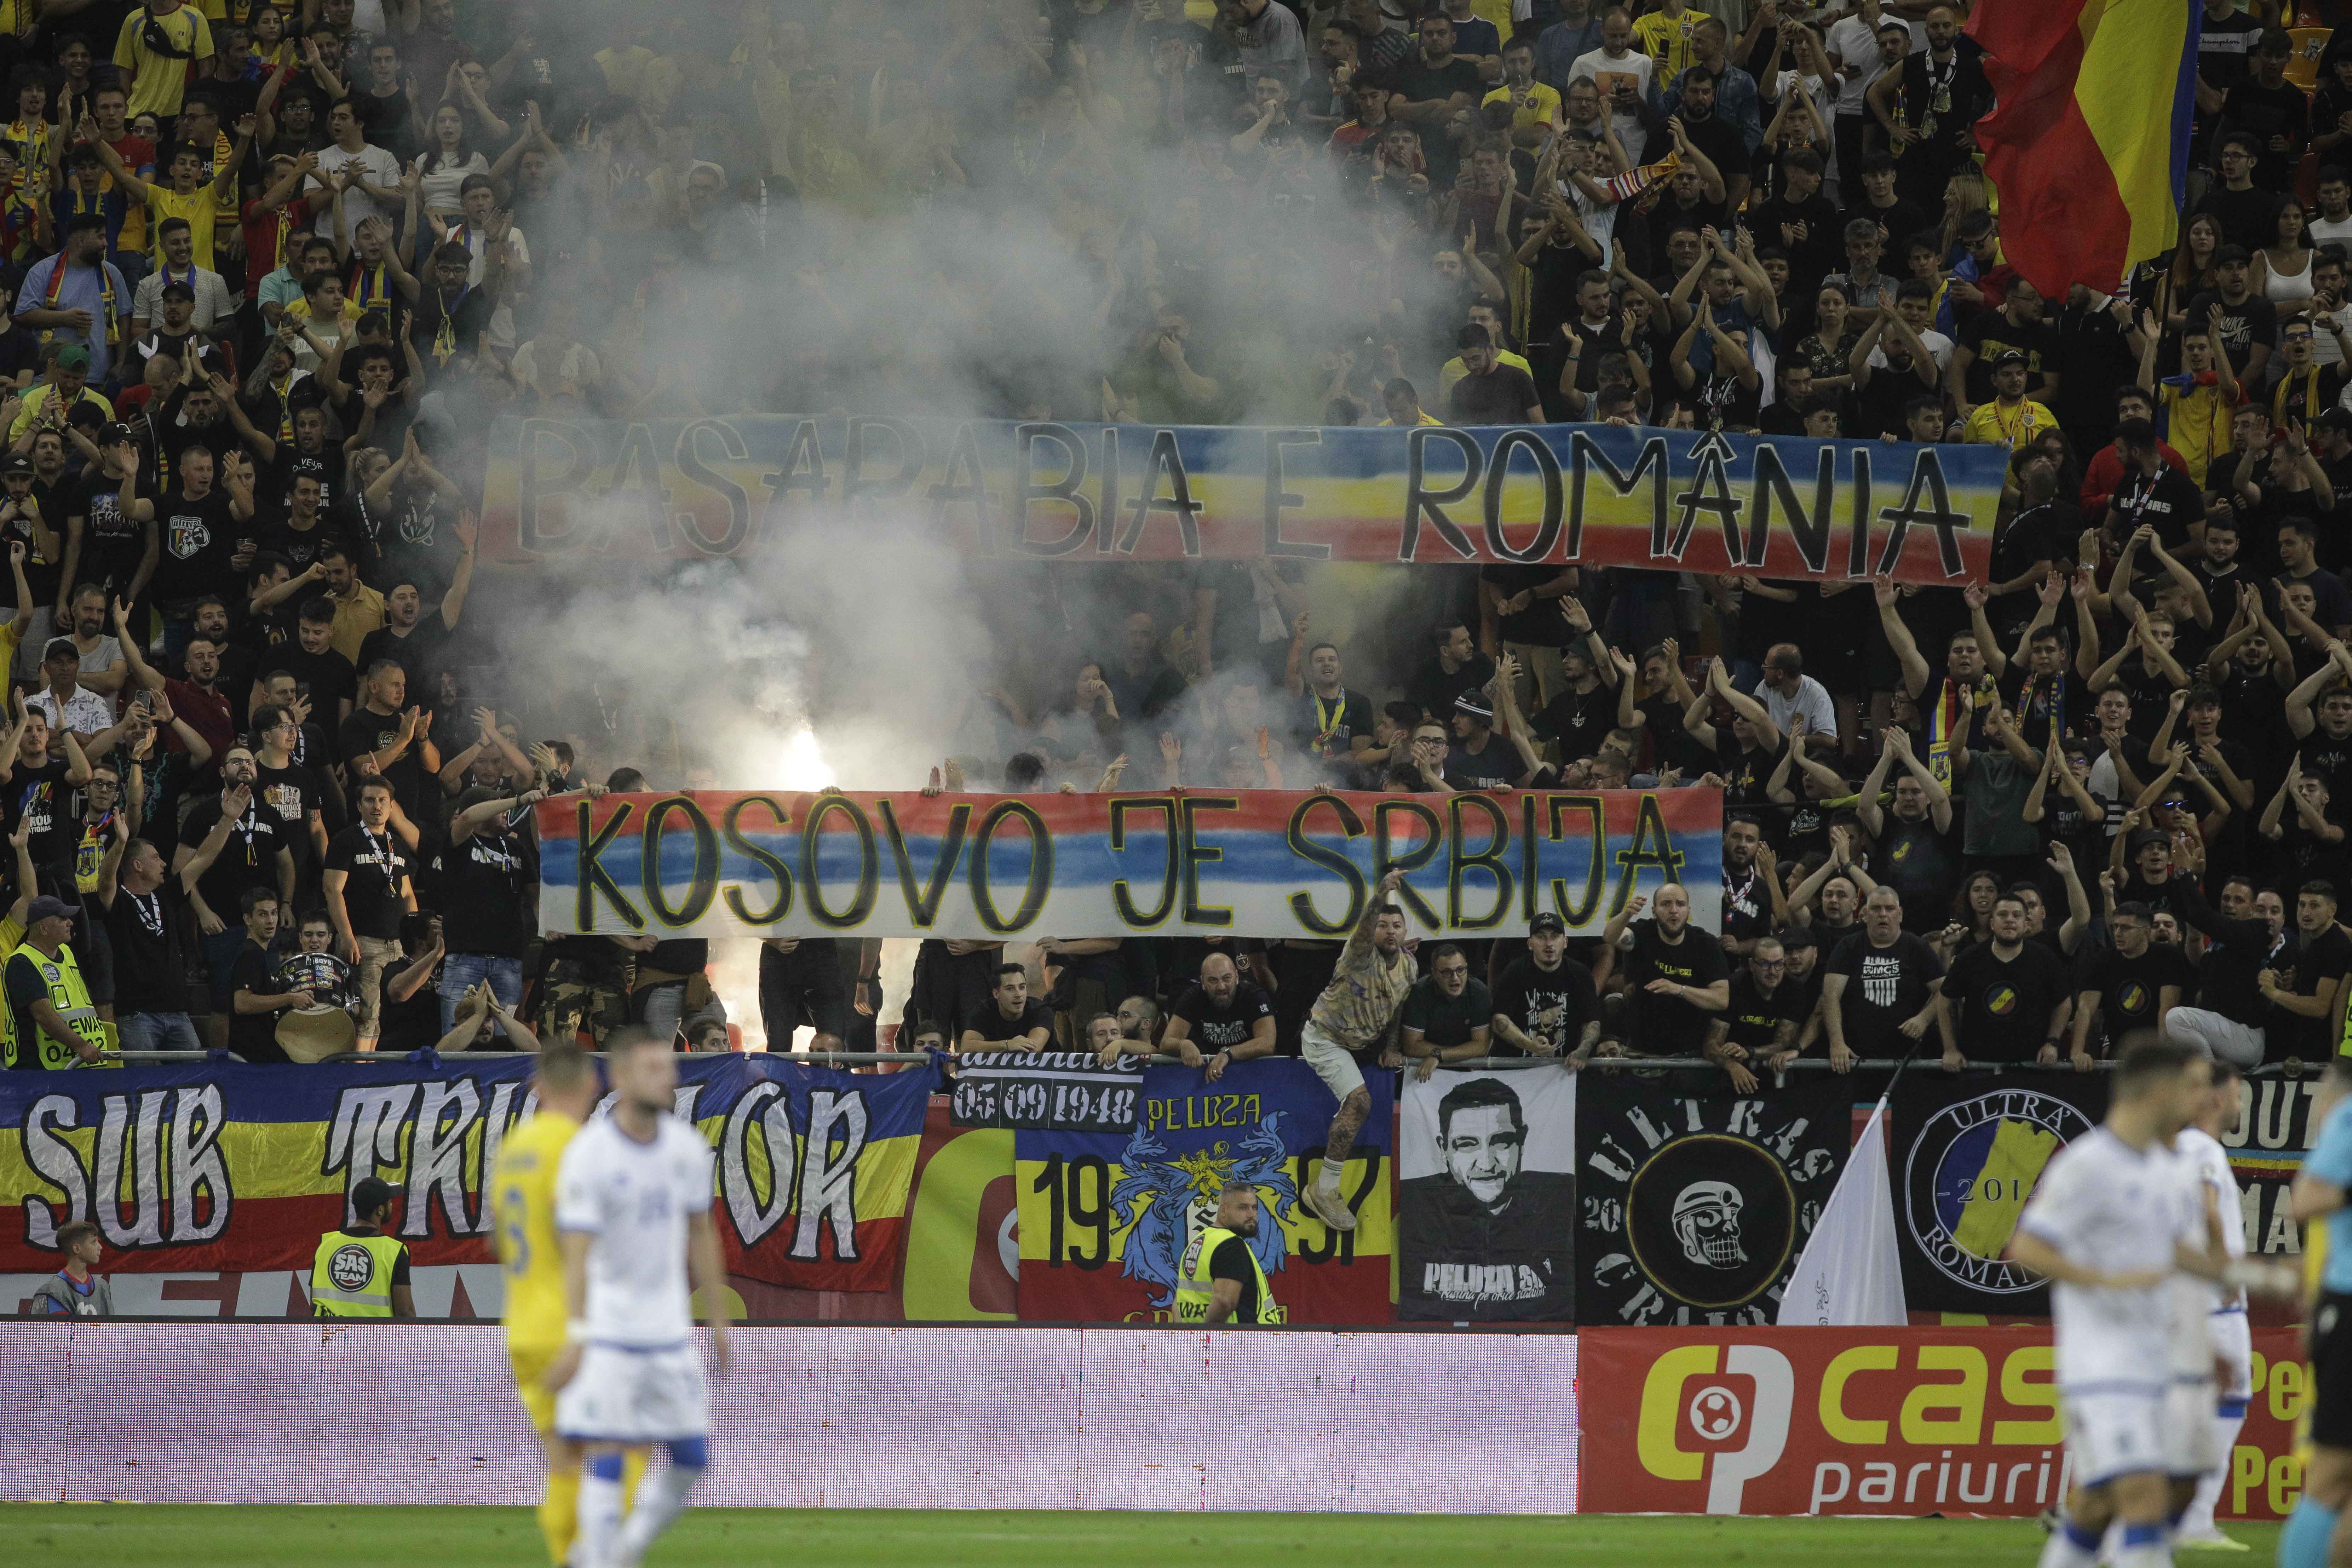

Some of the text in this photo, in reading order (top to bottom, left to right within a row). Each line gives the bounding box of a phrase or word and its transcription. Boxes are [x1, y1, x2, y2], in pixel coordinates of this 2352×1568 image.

[1264, 428, 1332, 560] E
[1397, 427, 1972, 577] ROMÂNIA
[576, 794, 1692, 936] KOSOVO JE SRBIJA
[954, 1081, 1134, 1124] 05 09 1948
[1587, 1098, 1835, 1183] ULTRAS
[19, 1081, 234, 1253] SUB
[1033, 1151, 1110, 1270] 19
[1584, 1195, 1621, 1233] 20
[334, 1253, 368, 1274] SAS
[334, 1271, 366, 1282] TEAM
[1818, 1345, 2064, 1445] cas
[1810, 1450, 2072, 1514] pariuril
